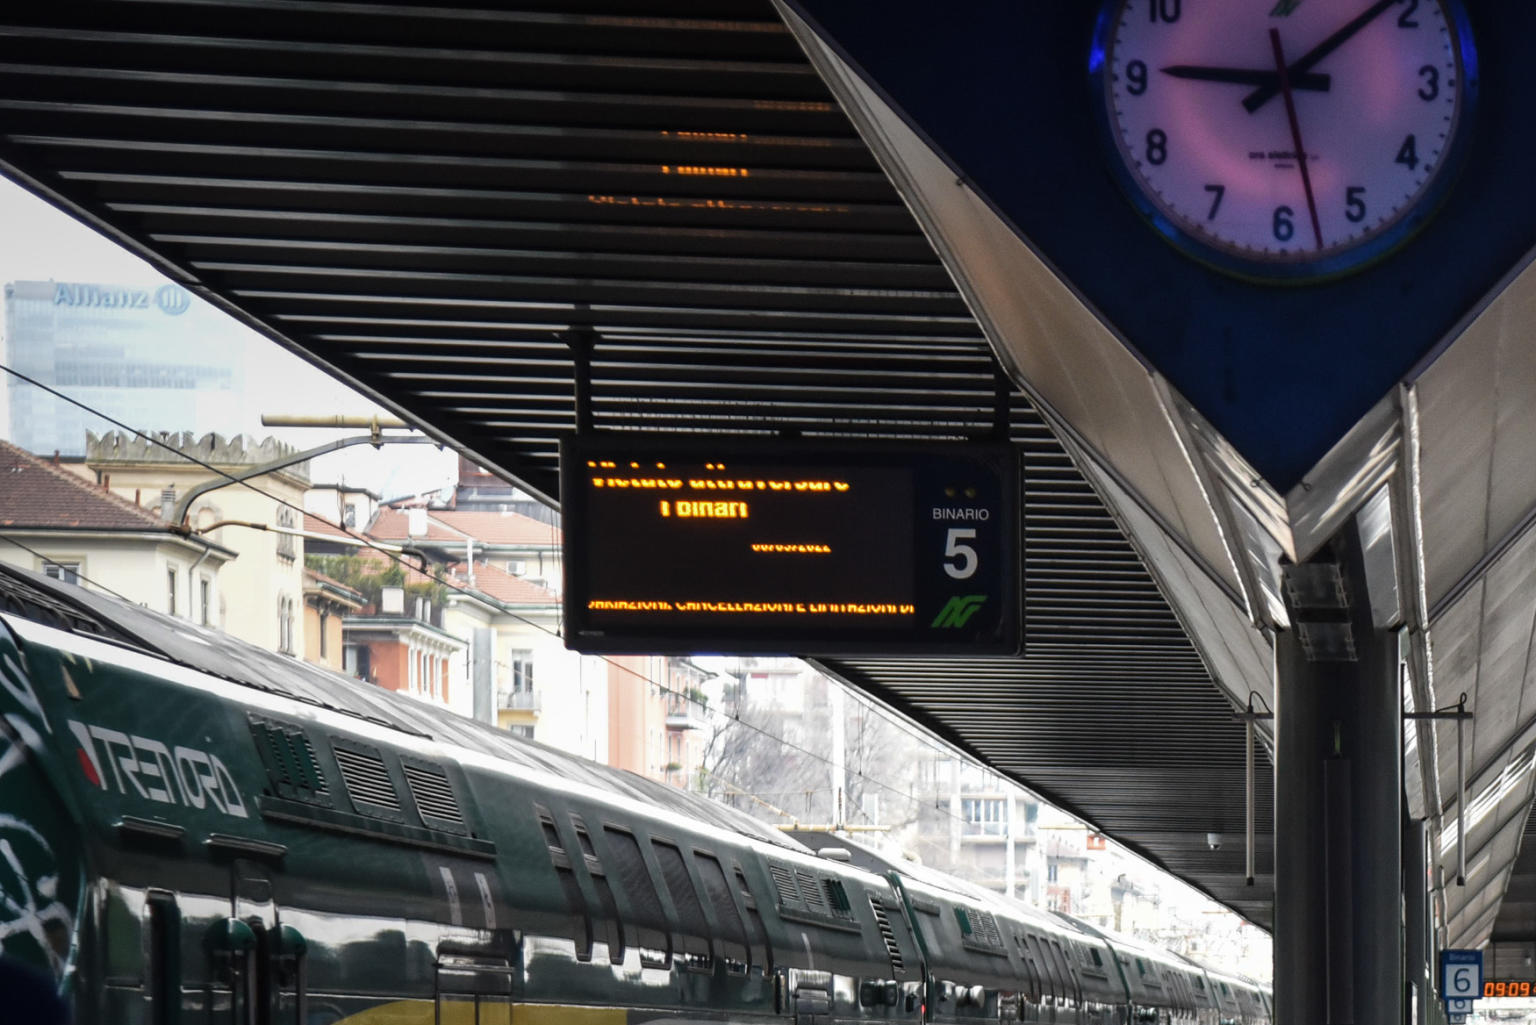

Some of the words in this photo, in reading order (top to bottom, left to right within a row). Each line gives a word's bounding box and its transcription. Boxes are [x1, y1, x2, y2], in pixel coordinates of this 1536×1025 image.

[1125, 60, 1148, 96] 9
[1417, 65, 1440, 101] 3
[1145, 129, 1168, 165] 8
[1394, 134, 1419, 170] 4
[1203, 184, 1226, 220] 7
[1344, 186, 1367, 222] 5
[1272, 206, 1295, 242] 6
[54, 282, 149, 309] Allianz
[932, 508, 989, 521] BINARIO
[943, 528, 978, 579] 5
[68, 719, 249, 819] TRENORD
[1454, 967, 1471, 993] 6
[1484, 982, 1530, 997] 09:09
